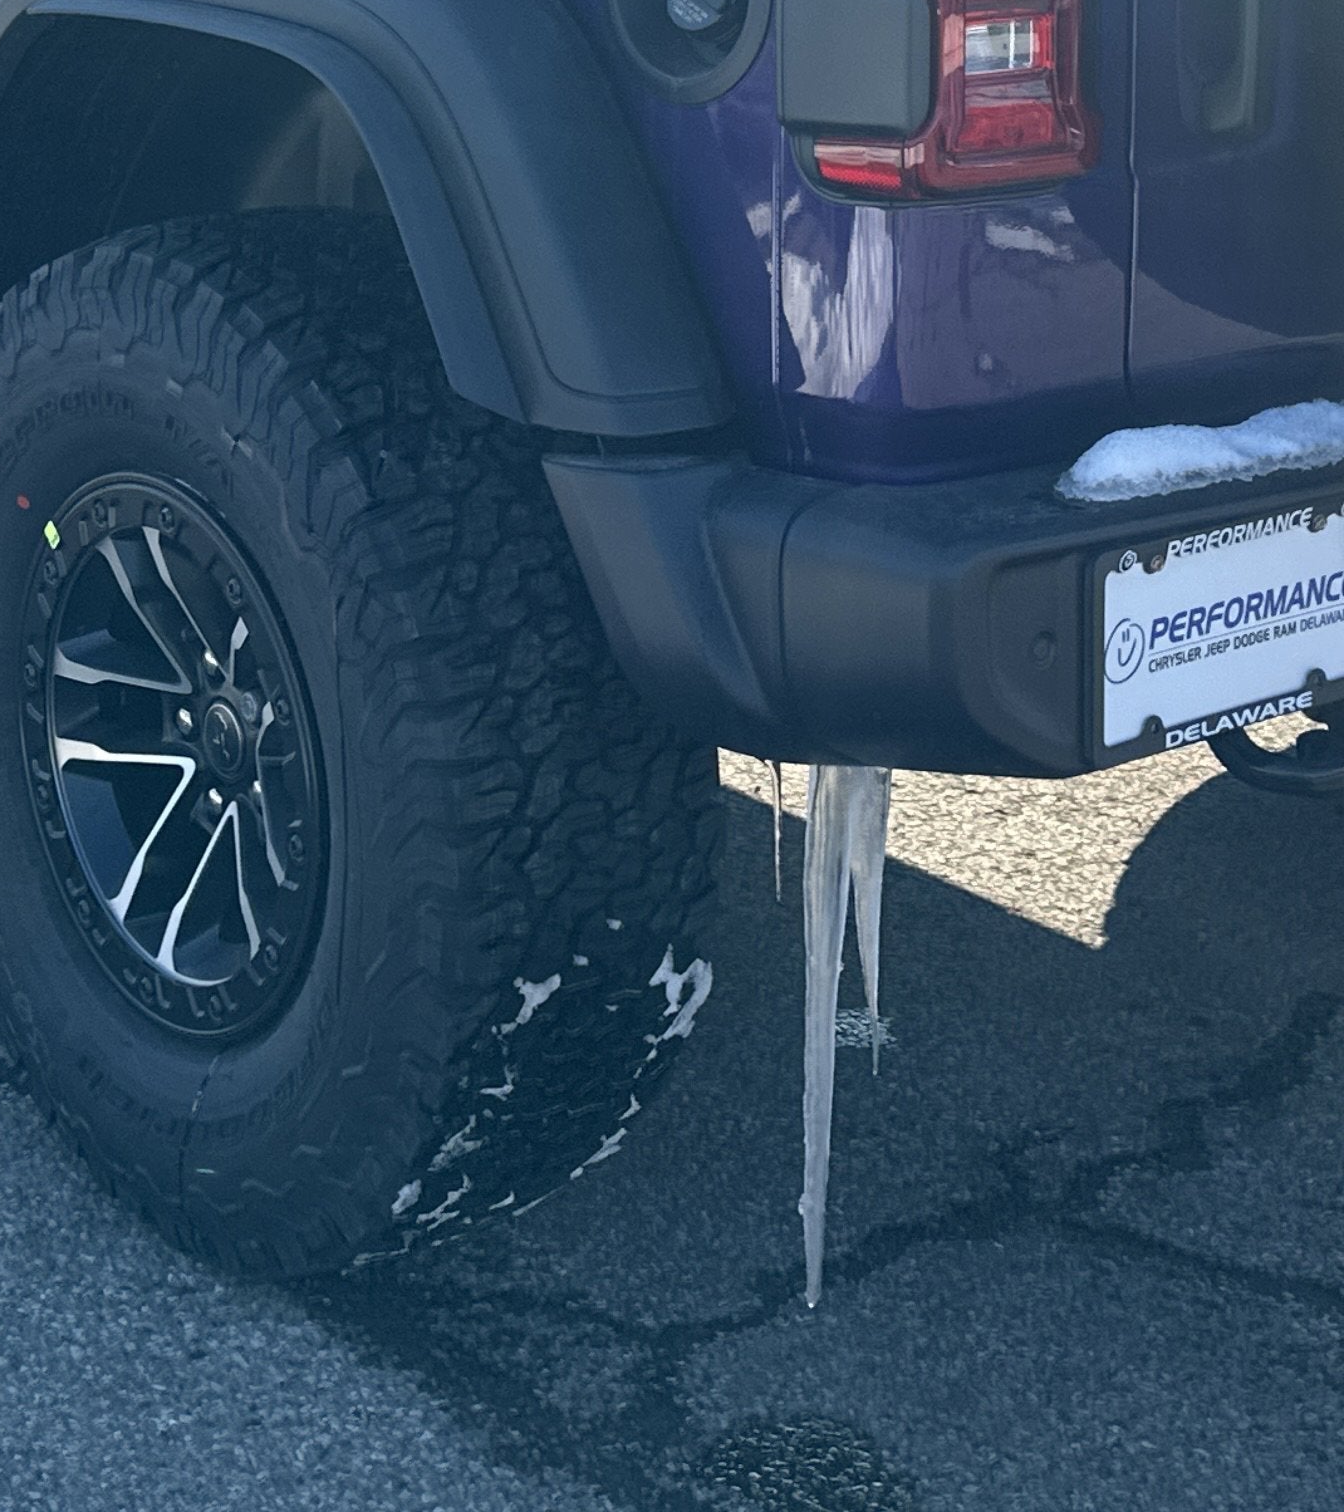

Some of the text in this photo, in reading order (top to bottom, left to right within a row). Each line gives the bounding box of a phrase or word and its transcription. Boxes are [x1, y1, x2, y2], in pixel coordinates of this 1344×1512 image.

[1167, 507, 1314, 560] PERFORMANCE
[1148, 647, 1202, 673] CHRYSLER
[1204, 638, 1231, 658] JEEP
[1233, 629, 1271, 650] DODGE
[1273, 621, 1297, 639] RAM
[1165, 690, 1314, 749] DELAWARE
